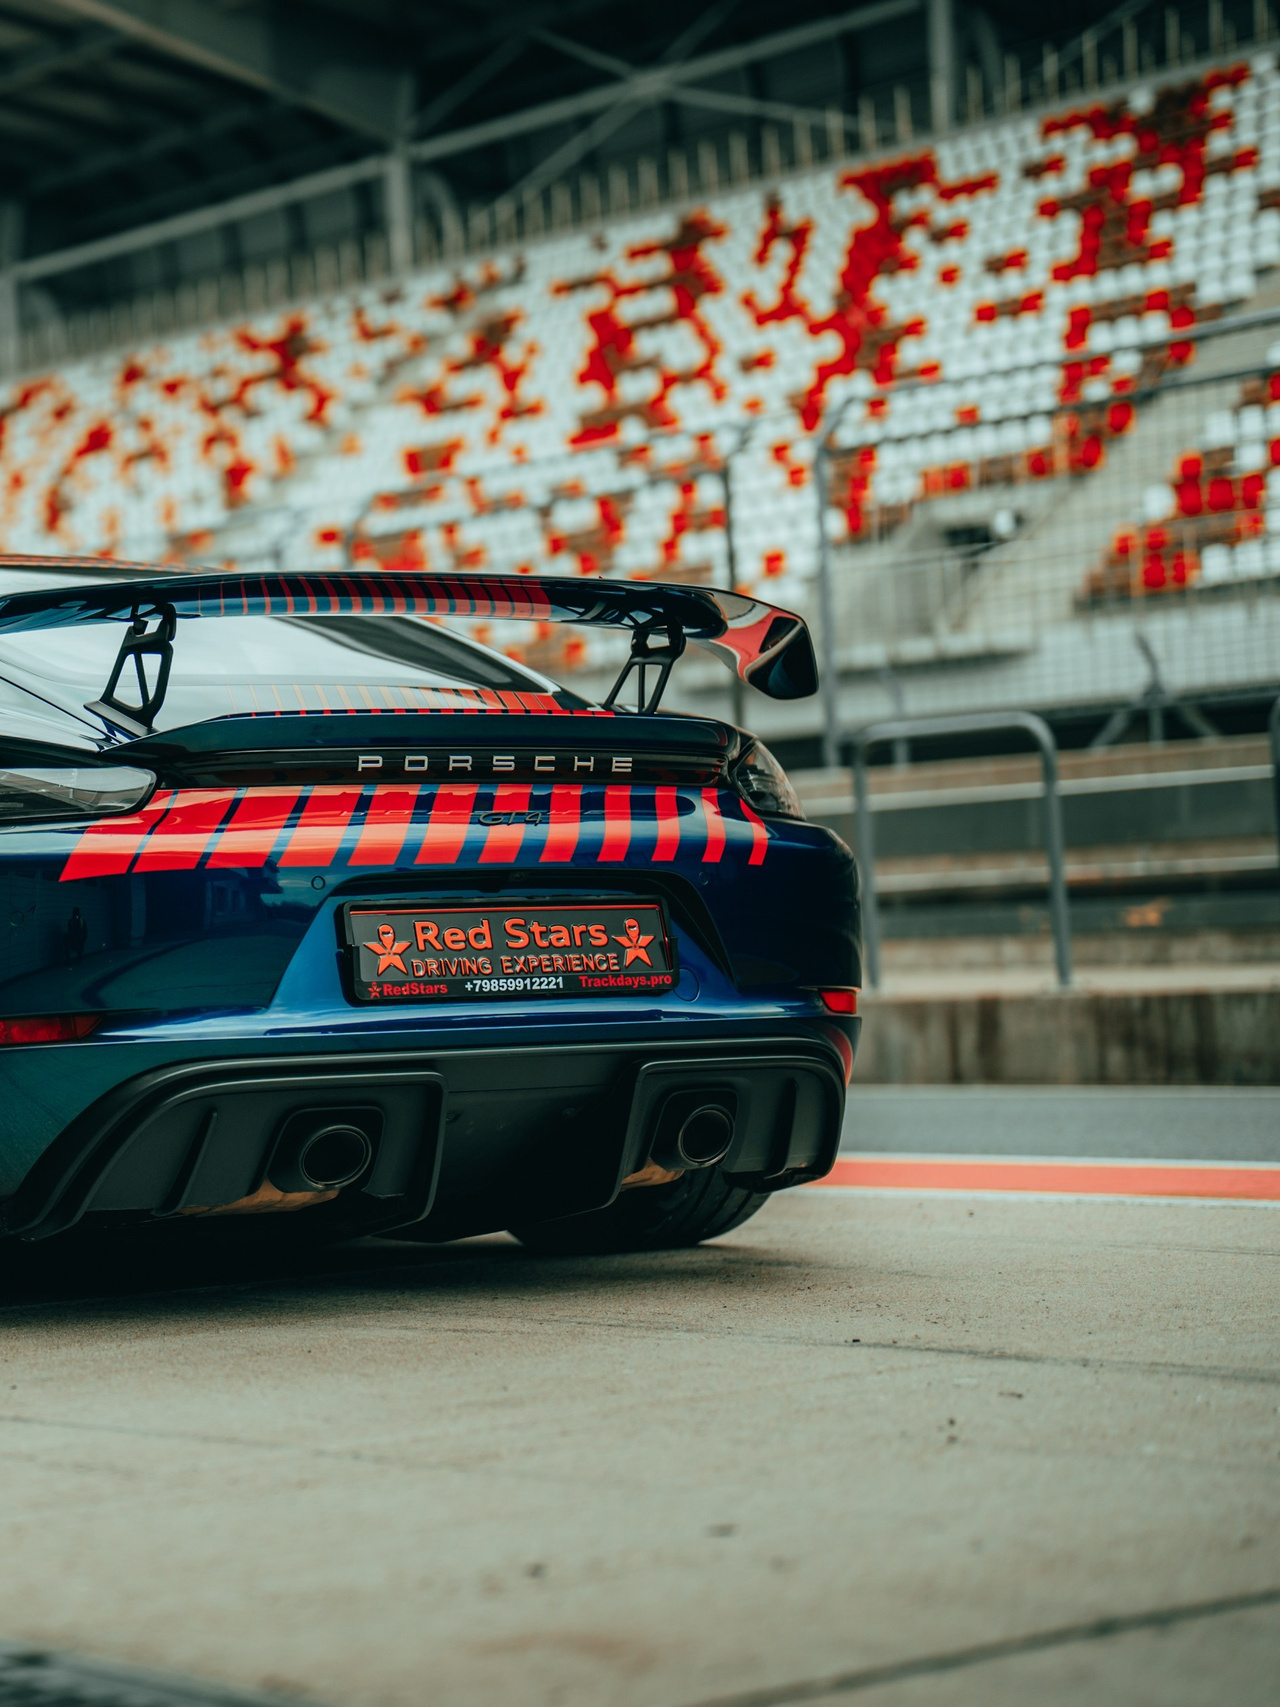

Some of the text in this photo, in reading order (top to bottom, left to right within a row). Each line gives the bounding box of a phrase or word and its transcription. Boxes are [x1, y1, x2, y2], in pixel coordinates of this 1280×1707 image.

[358, 755, 633, 772] PORSCHE
[478, 811, 542, 826] GT4
[413, 918, 609, 951] Red Stars
[411, 953, 620, 978] DRIVING EXPERIENCE
[383, 974, 673, 996] RedStars +79859912221 Trackdays.pro
